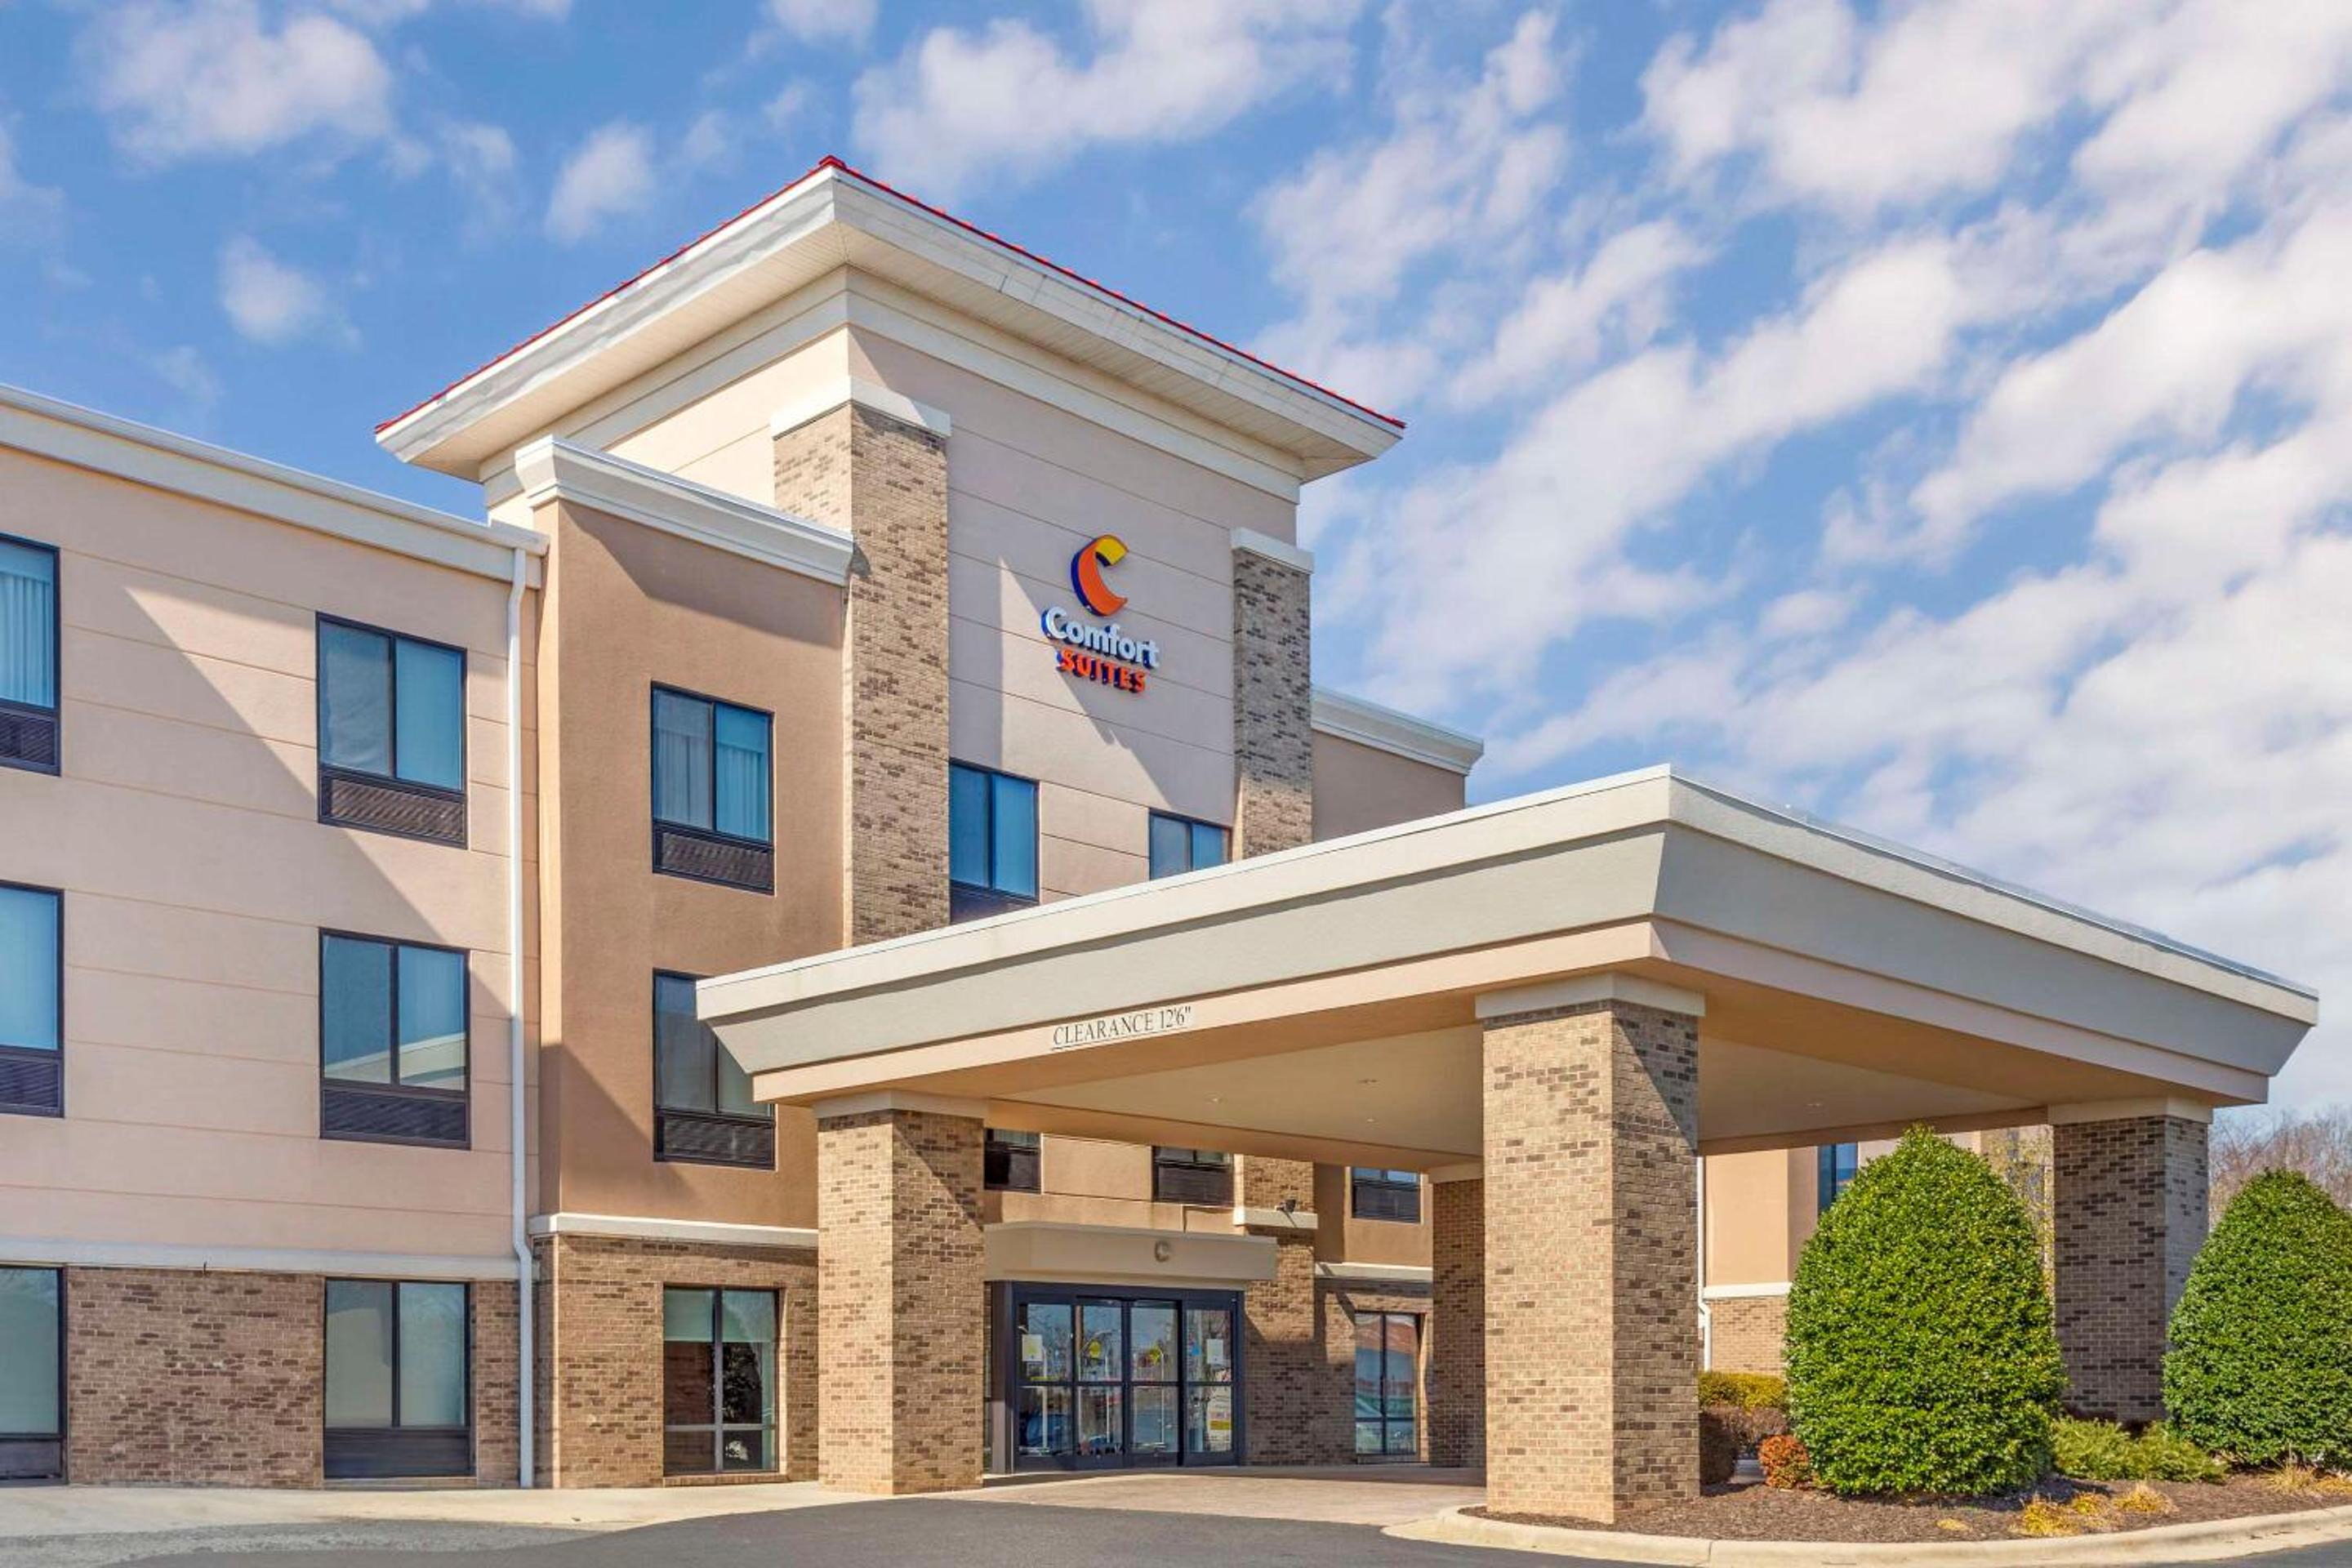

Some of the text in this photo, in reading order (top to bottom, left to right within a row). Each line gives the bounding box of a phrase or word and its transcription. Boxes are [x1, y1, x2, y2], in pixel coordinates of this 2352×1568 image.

[1041, 607, 1160, 668] Comfort
[1055, 648, 1147, 693] SUITES
[1053, 1013, 1154, 1046] CLEARANCE
